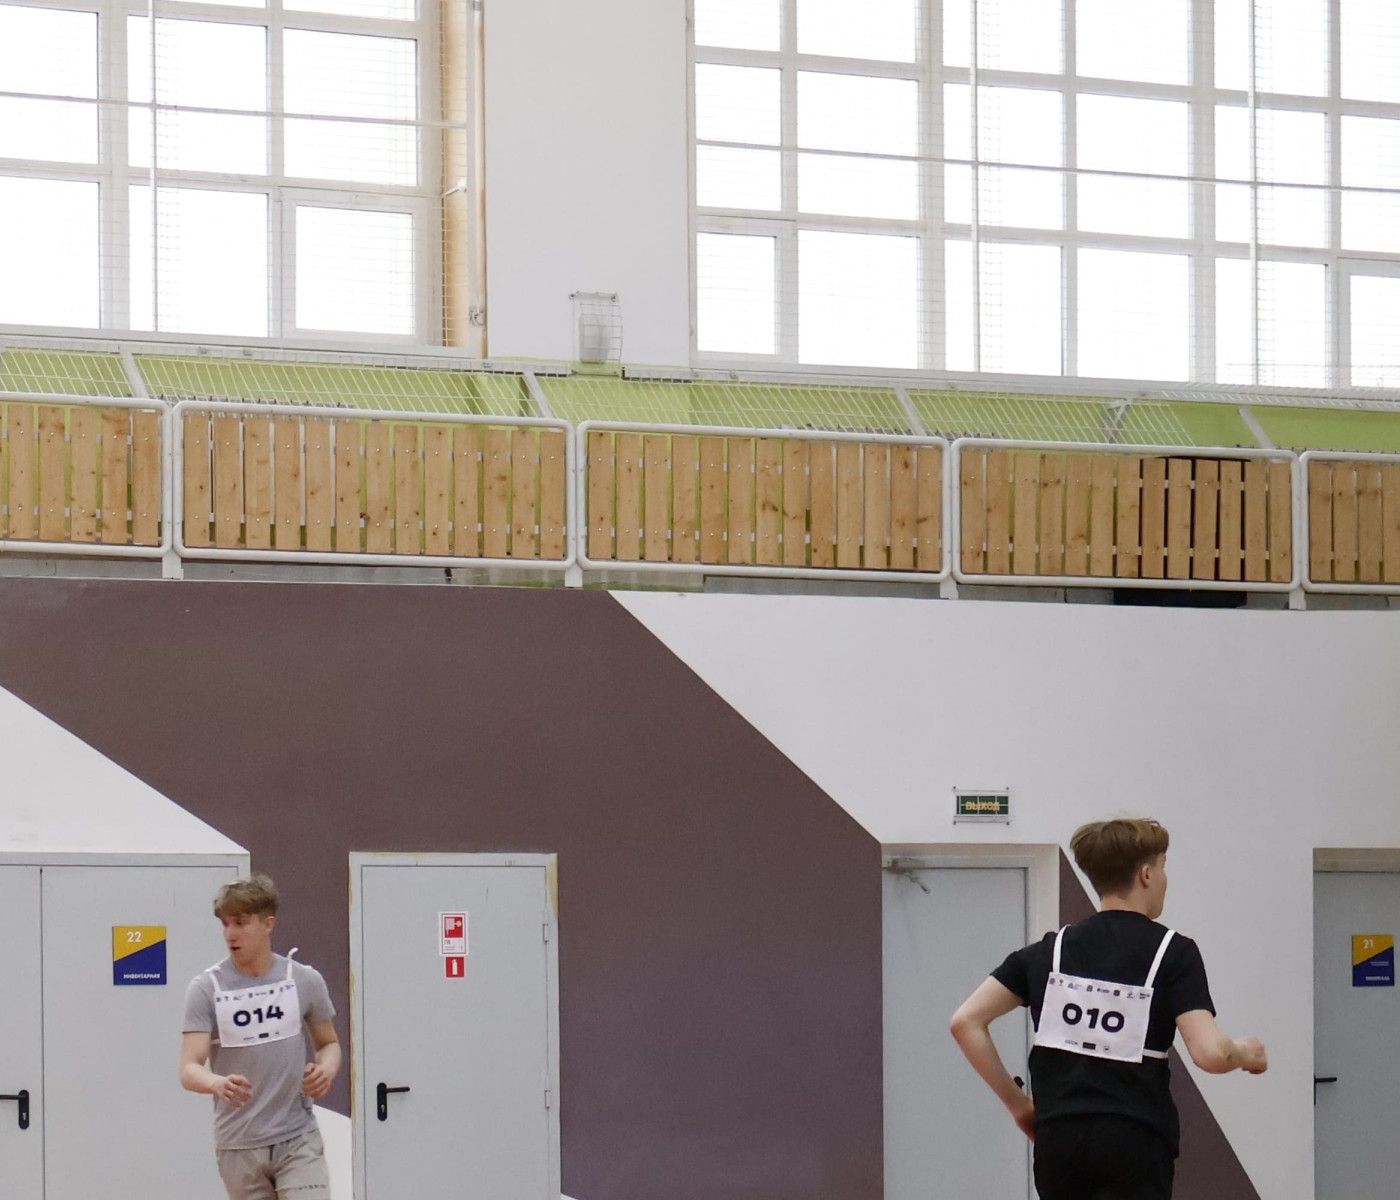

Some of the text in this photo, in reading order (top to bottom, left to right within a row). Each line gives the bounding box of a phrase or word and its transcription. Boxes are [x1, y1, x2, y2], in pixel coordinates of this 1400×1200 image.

[965, 801, 1000, 812] ВЫХОД
[127, 931, 142, 943] 22
[233, 1005, 284, 1027] 014
[1062, 1003, 1125, 1033] 010
